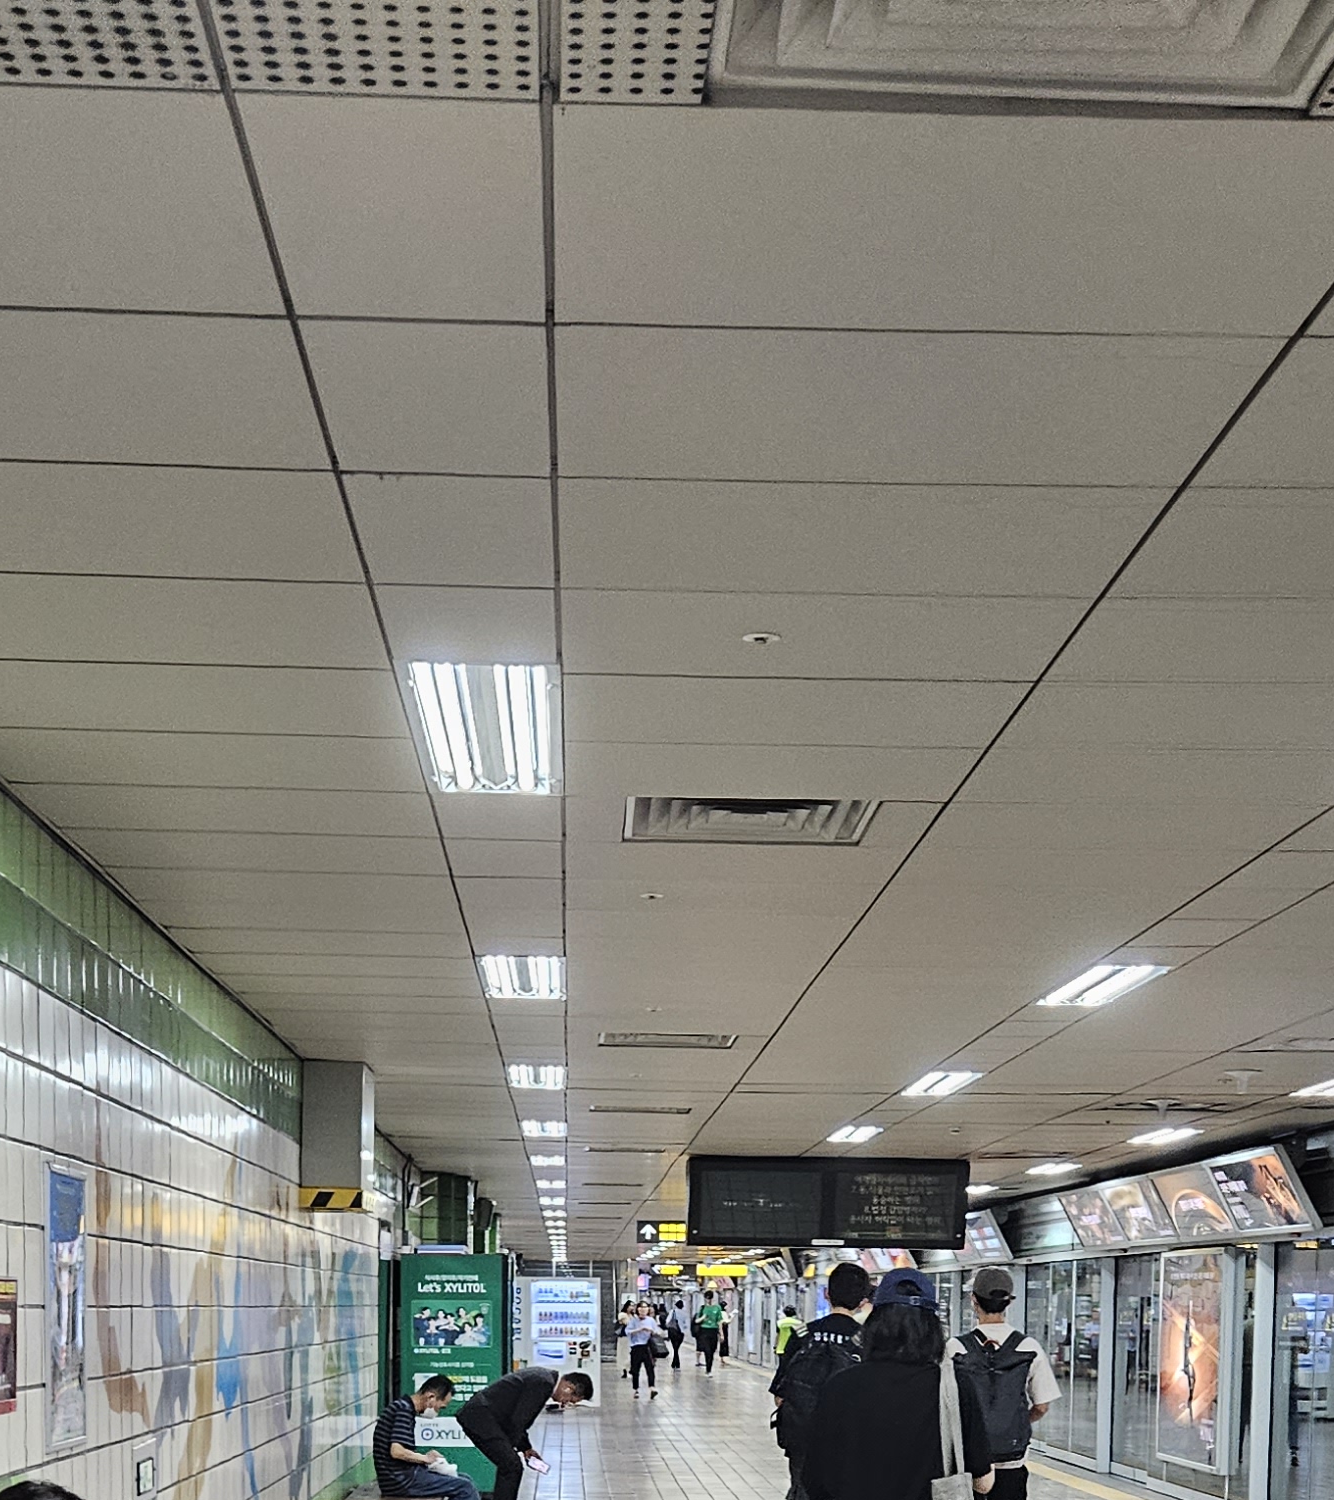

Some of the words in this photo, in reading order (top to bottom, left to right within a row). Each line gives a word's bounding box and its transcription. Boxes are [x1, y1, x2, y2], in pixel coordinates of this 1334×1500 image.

[417, 1281, 442, 1293] Let's
[444, 1282, 487, 1293] XYLITOL
[435, 1429, 466, 1440] XYLI
